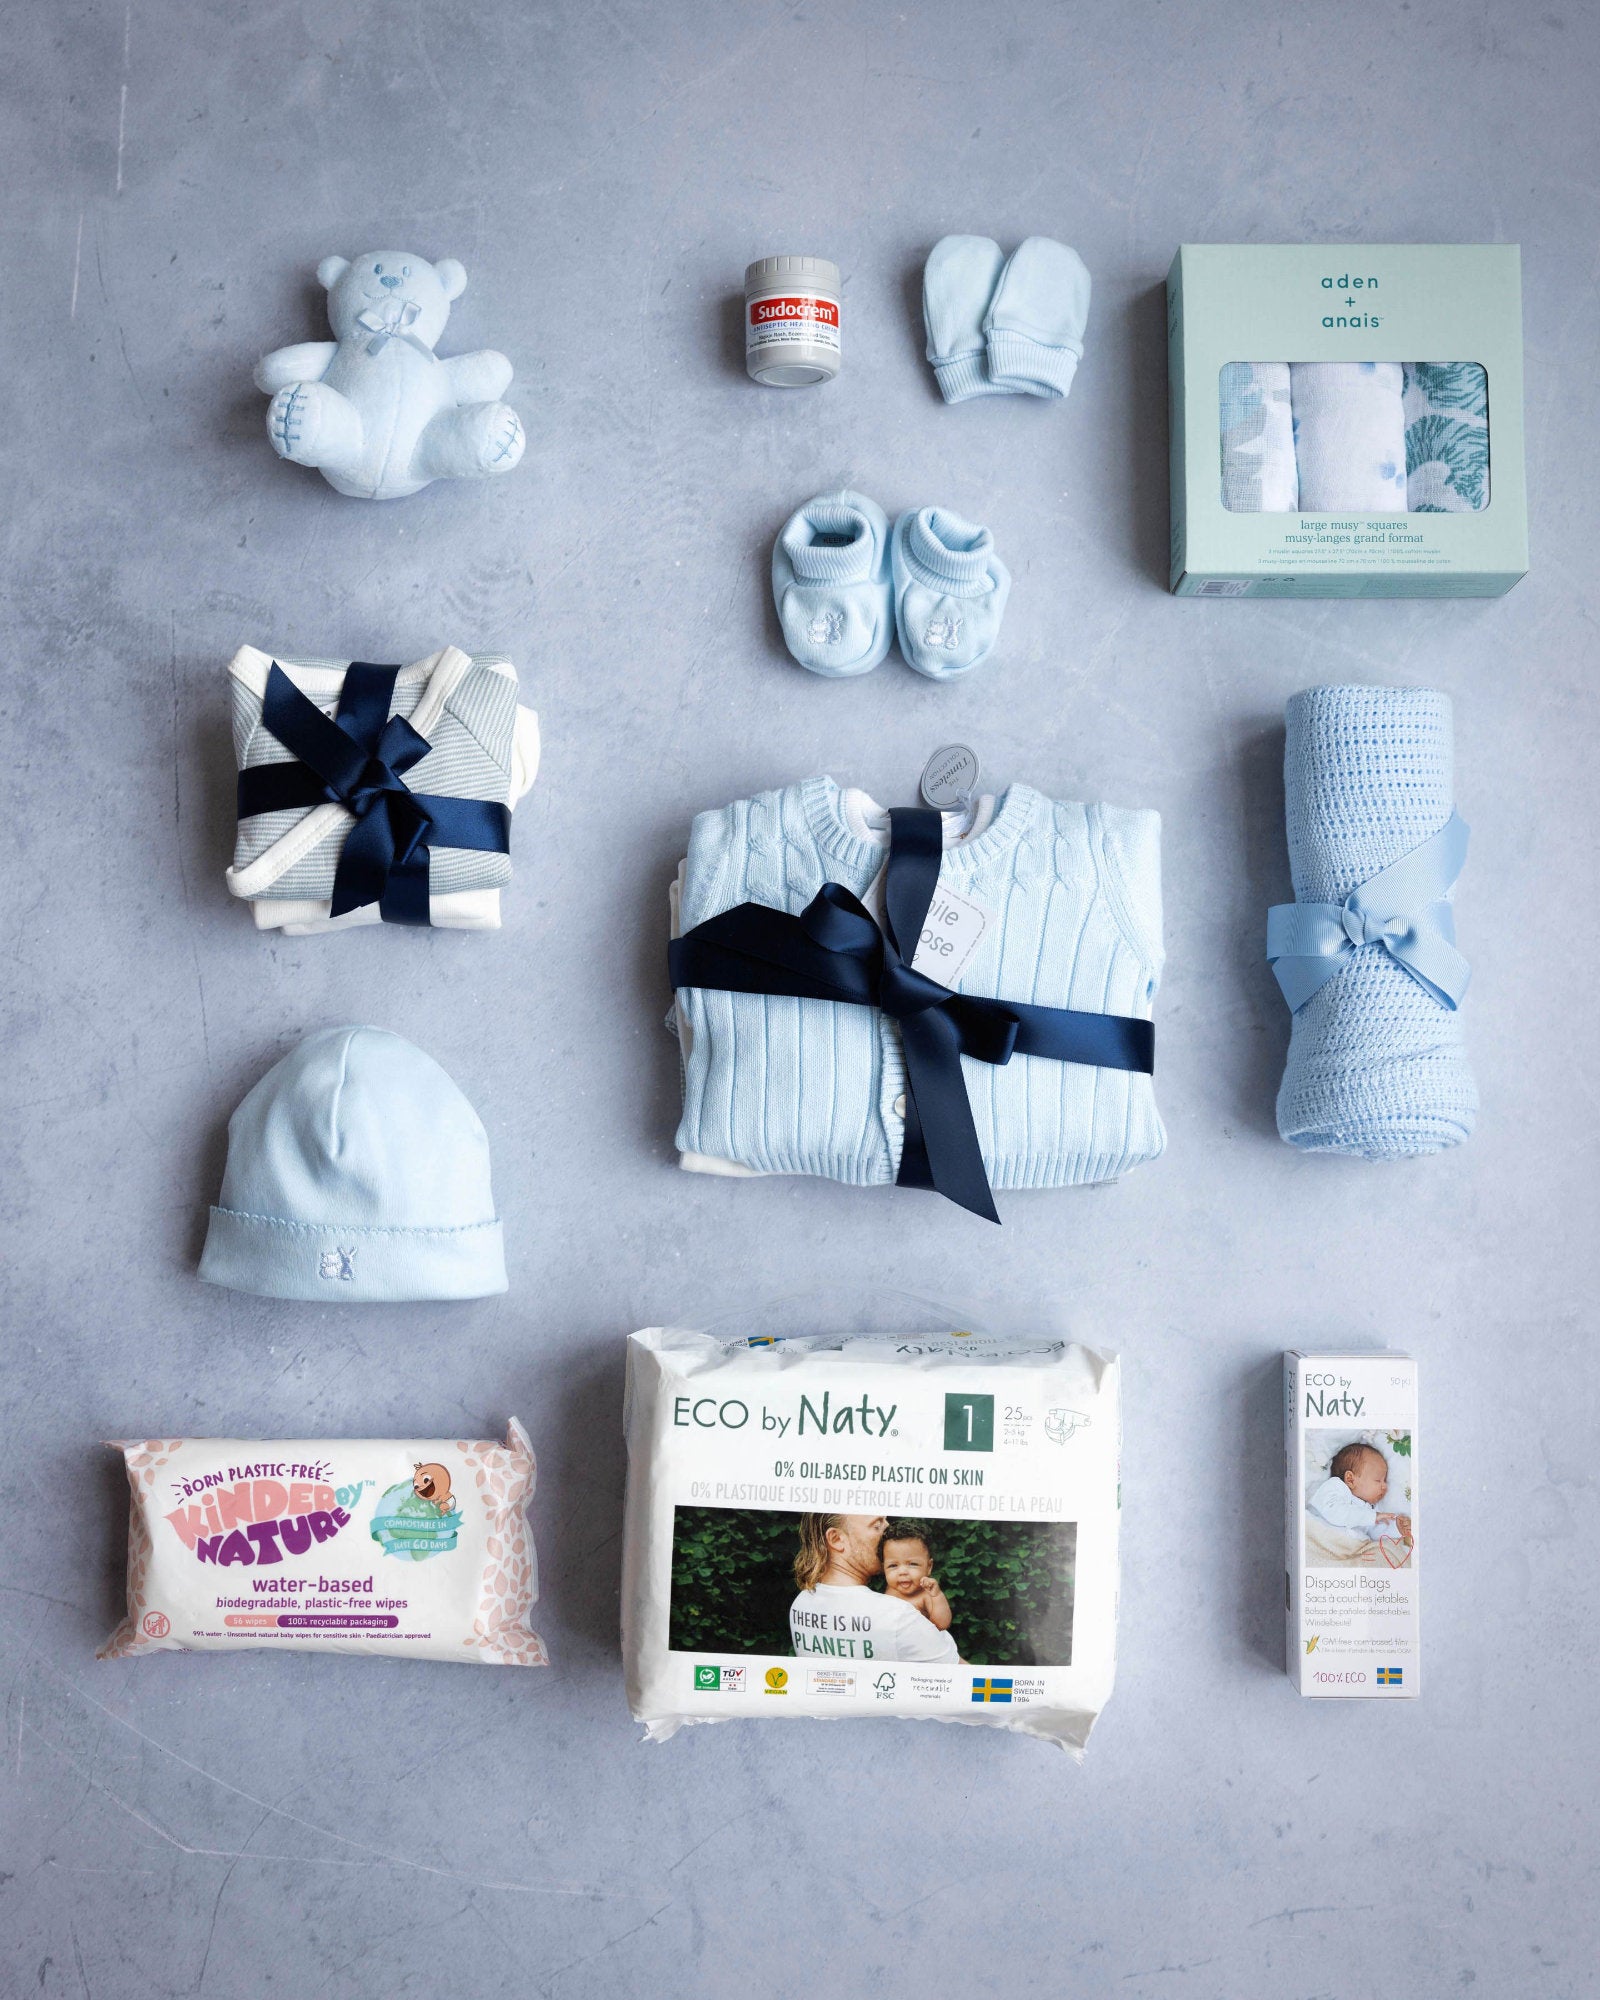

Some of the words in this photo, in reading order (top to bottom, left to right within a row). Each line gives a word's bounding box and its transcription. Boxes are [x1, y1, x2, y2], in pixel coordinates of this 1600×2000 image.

[1321, 273, 1378, 289] aden
[758, 301, 832, 320] Sudocrem
[753, 321, 787, 333] ANTISEPTIC
[1322, 312, 1379, 328] anais
[1301, 520, 1327, 532] large
[1331, 522, 1359, 532] musy
[1366, 521, 1408, 532] squares
[1285, 533, 1350, 545] musy-langes
[1354, 533, 1385, 545] grand
[1388, 533, 1423, 543] format
[929, 751, 960, 780] COLLECTION
[930, 757, 971, 792] Timeless
[920, 929, 954, 957] ose
[1305, 1373, 1336, 1387] ECO
[1339, 1376, 1352, 1389] by
[1305, 1389, 1365, 1418] Naty
[674, 1396, 749, 1429] ECO
[762, 1406, 791, 1438] by
[1004, 1406, 1022, 1420] 25
[963, 1404, 973, 1442] 1
[182, 1471, 224, 1497] BORN
[228, 1463, 323, 1482] PLASTIC-FREE
[774, 1461, 795, 1478] 0%
[800, 1462, 866, 1481] OIL-BASED
[872, 1465, 924, 1484] PLASTIC
[929, 1468, 948, 1485] ON
[953, 1469, 984, 1487] SKIN
[691, 1481, 711, 1498] 0%
[716, 1482, 785, 1504] PLASTIQUE
[790, 1487, 818, 1504] ISSU
[823, 1489, 841, 1505] DU
[847, 1486, 901, 1508] PÉTROLE
[905, 1491, 923, 1509] AU
[928, 1493, 984, 1512] CONTACT
[989, 1495, 1005, 1512] DE
[1010, 1496, 1026, 1513] LA
[1031, 1496, 1062, 1514] PEAU
[384, 1519, 436, 1529] COMPOSTABLE
[438, 1521, 447, 1529] IN
[197, 1506, 351, 1567] NATURE
[413, 1540, 428, 1550] 60
[430, 1541, 448, 1549] DAYS
[252, 1575, 373, 1593] water-based
[1305, 1574, 1357, 1592] Disposal
[1360, 1575, 1391, 1592] Bags
[216, 1597, 301, 1610] biodegradable,
[305, 1597, 371, 1610] plastic-free
[376, 1597, 408, 1611] wipes
[1305, 1592, 1327, 1603] Sacs
[1336, 1593, 1372, 1603] couches
[1374, 1593, 1409, 1606] jetables
[1328, 1607, 1337, 1615] de
[233, 1617, 243, 1625] 56
[245, 1618, 268, 1627] wipes
[287, 1617, 308, 1626] 100%
[310, 1618, 348, 1628] recyclable
[350, 1618, 388, 1628] packaging
[792, 1608, 828, 1630] THERE
[833, 1615, 846, 1631] IS
[852, 1615, 871, 1632] NO
[794, 1631, 856, 1658] PLANET
[863, 1639, 874, 1659] B
[722, 1668, 744, 1678] TÜV
[1313, 1671, 1343, 1684] 100%
[1345, 1671, 1367, 1684] ECO
[876, 1692, 895, 1700] FSC
[913, 1684, 950, 1692] renewable
